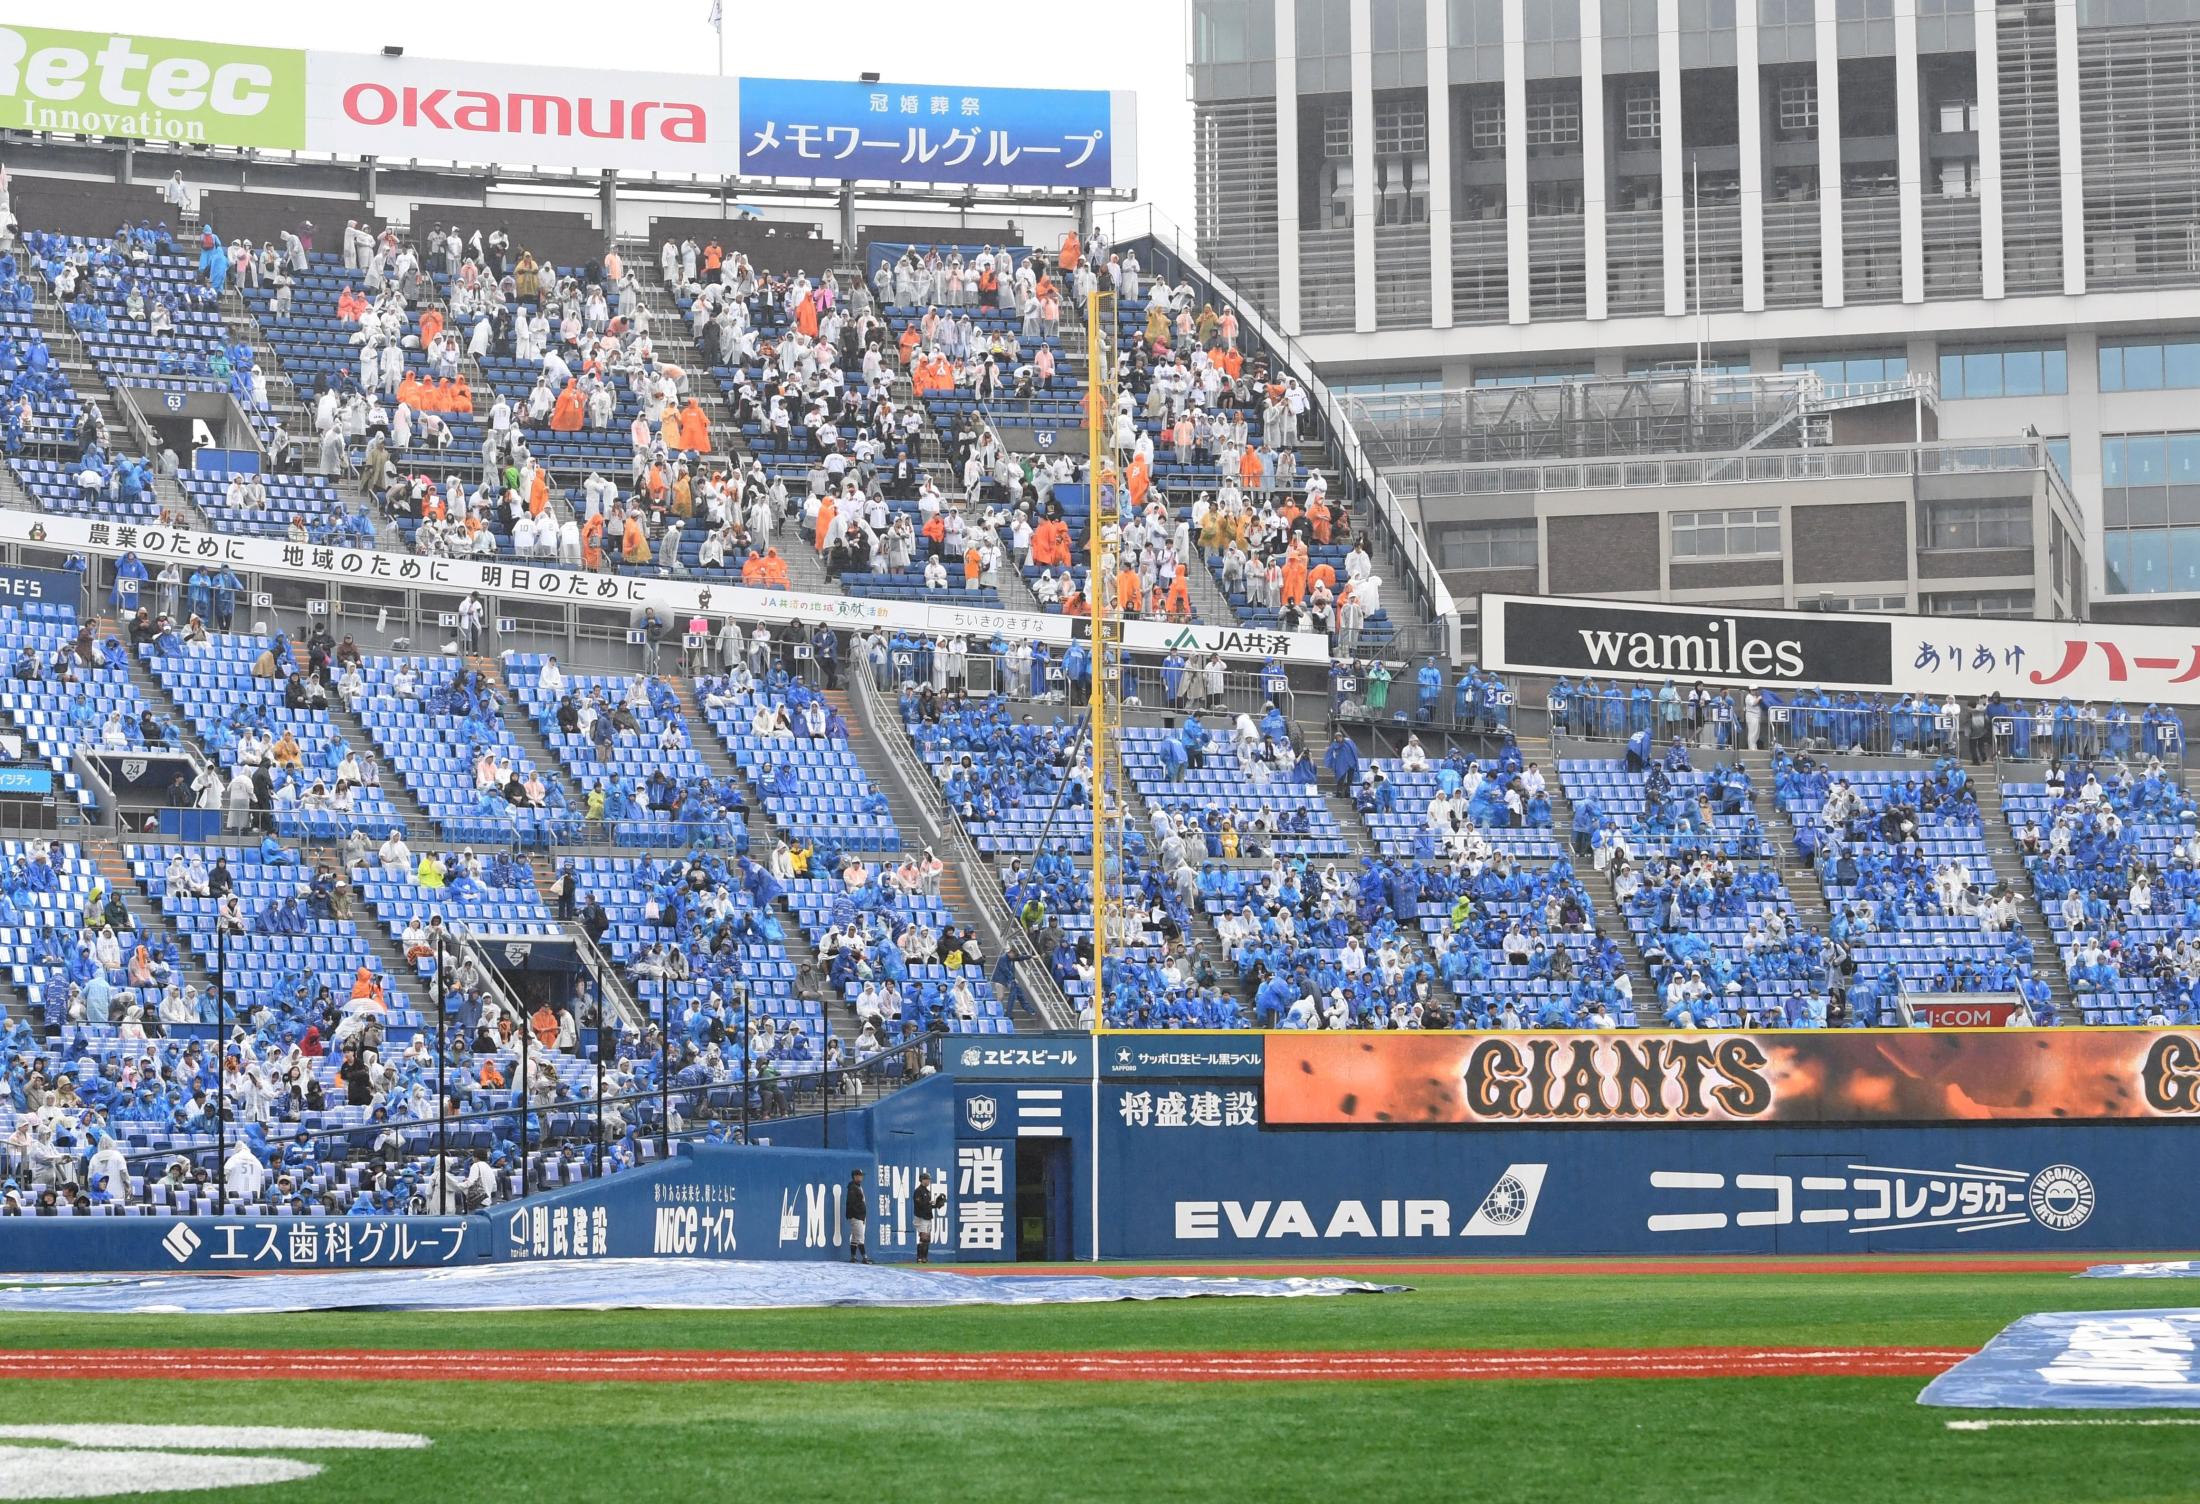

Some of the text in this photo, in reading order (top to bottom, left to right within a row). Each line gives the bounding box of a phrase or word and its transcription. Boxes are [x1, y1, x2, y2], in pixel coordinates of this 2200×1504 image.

[23, 101, 206, 141] Innovation
[869, 93, 980, 117] 冠婚葬祭
[746, 121, 1103, 169] メモワールグループ
[167, 395, 182, 408] 63
[1038, 433, 1053, 445] 64
[88, 523, 648, 601] 農業のために 地域のために 明日のために
[954, 612, 1045, 633] ちいきのきずな
[1206, 630, 1291, 656] JA共済
[1578, 618, 1805, 677] wamiles
[1914, 640, 2026, 676] ありあけ
[126, 764, 140, 775] 24
[1138, 1053, 1261, 1065] サッポロ生ビール黒ラベル
[1465, 1038, 1772, 1118] GIANTS
[969, 1099, 994, 1115] 100
[1119, 1091, 1258, 1127] 将盛建設
[2035, 1167, 2089, 1191] NICONICO
[958, 1146, 1004, 1249] 消毒
[1647, 1171, 2025, 1232] ニコニコレンタカー
[2035, 1203, 2089, 1227] RENTACAR
[210, 1221, 468, 1264] エス歯科グループ
[533, 1205, 608, 1257] 則武建設
[702, 1206, 737, 1253] ナイス
